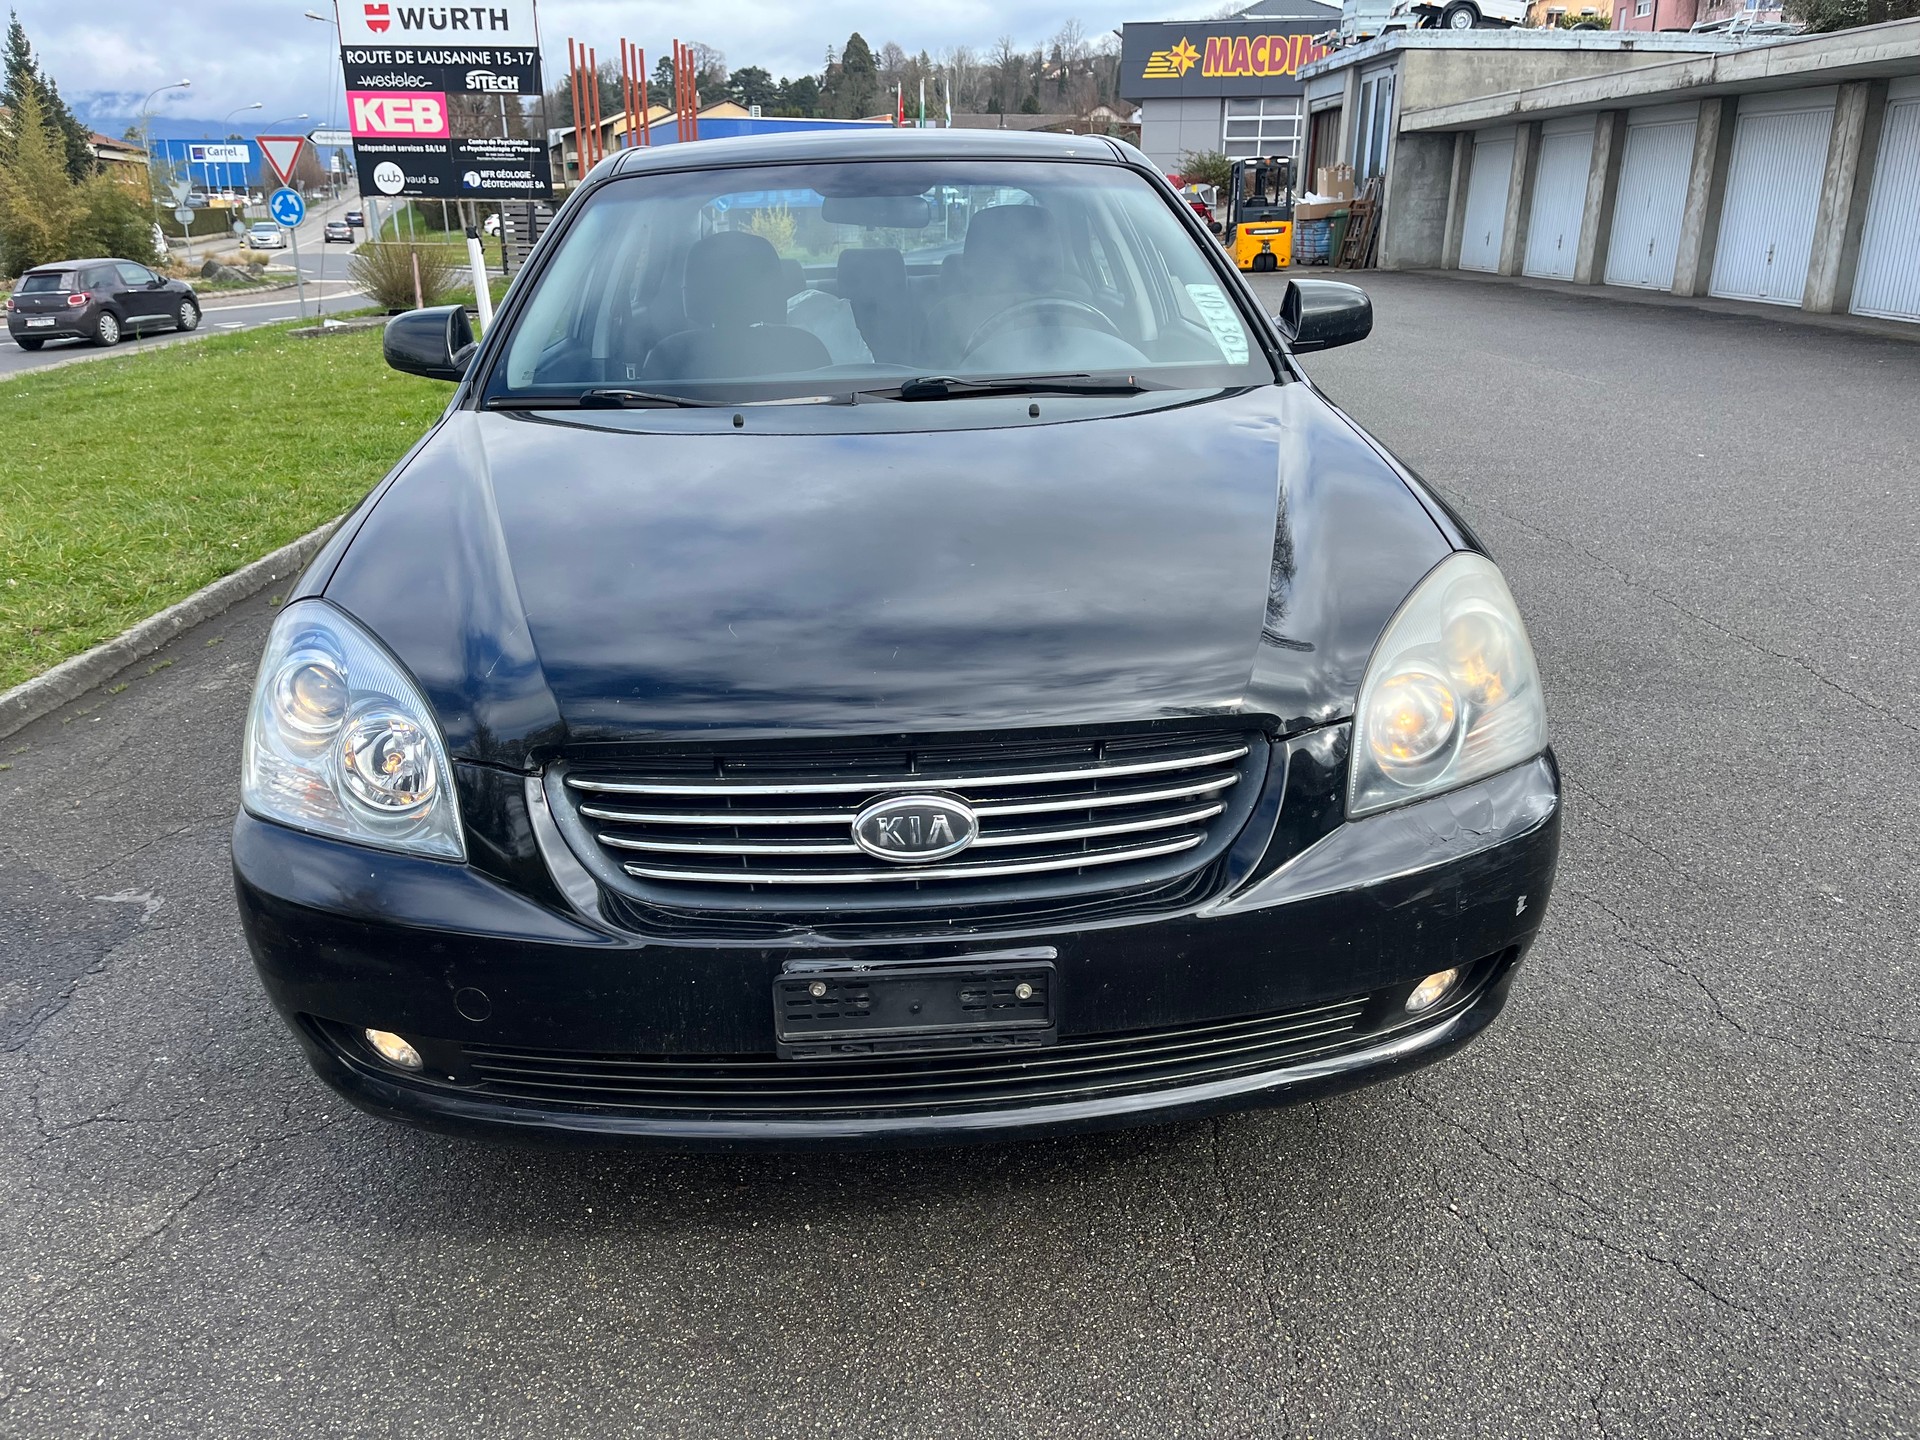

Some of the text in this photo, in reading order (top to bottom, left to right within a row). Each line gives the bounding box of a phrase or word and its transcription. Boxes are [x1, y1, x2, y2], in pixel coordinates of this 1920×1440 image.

[397, 7, 509, 31] WÜRTH
[346, 51, 534, 65] ROUTE DE LAUSANNE 15-17
[1202, 35, 1334, 77] MACDIM
[357, 72, 433, 87] westelec
[465, 75, 519, 90] SITECH
[353, 98, 444, 132] KEB
[207, 147, 237, 156] Carrel
[397, 144, 424, 153] services
[405, 175, 427, 184] vaud
[428, 176, 440, 184] sa
[480, 170, 496, 179] MFR
[496, 169, 531, 179] GÉOLOGIE
[481, 179, 545, 189] GÉOTECHNIQUE SA
[876, 815, 955, 847] KIA
